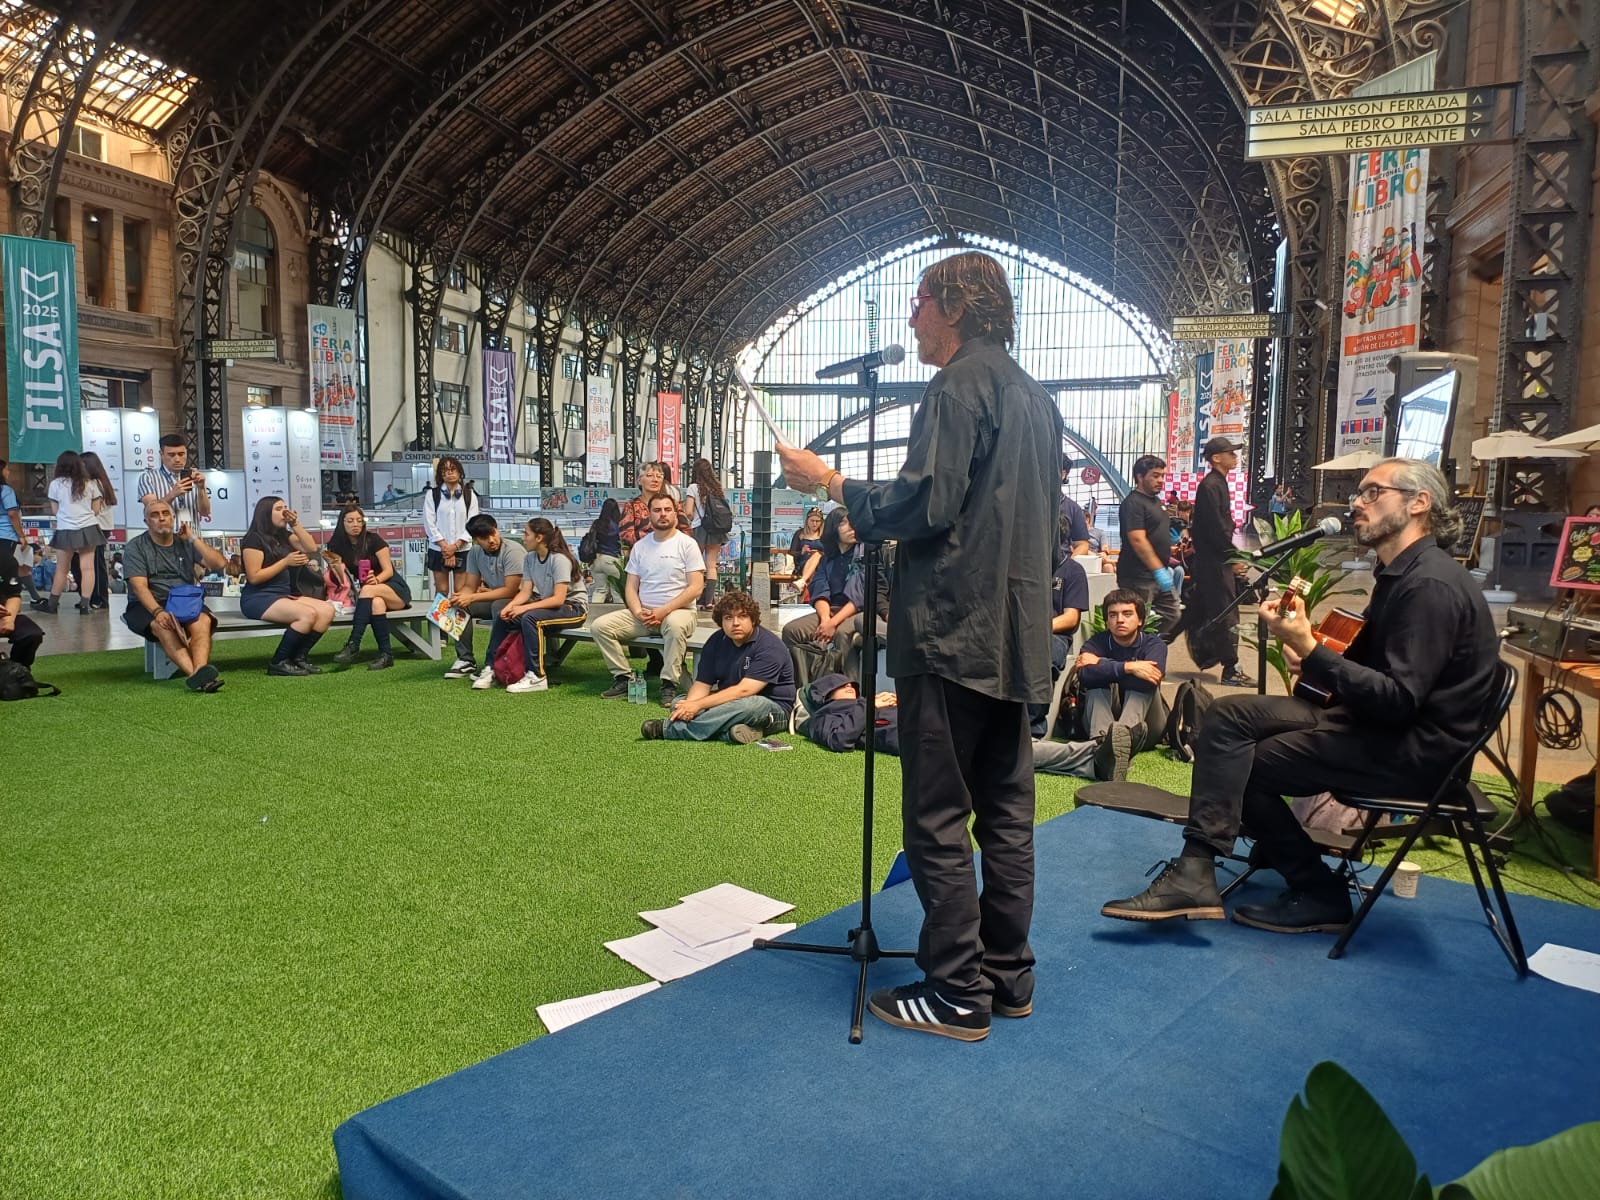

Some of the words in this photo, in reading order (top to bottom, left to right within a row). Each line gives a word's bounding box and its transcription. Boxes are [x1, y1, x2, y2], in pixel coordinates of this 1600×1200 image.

[1255, 109, 1293, 123] SALA
[1298, 102, 1384, 120] TENNYSON
[1389, 96, 1460, 112] FERRADA
[1299, 122, 1337, 136] SALA
[1342, 117, 1396, 132] PEDRO
[1401, 111, 1459, 127] PRADO
[1345, 128, 1458, 149] RESTAURANTE
[1356, 149, 1421, 183] FERIA
[1353, 167, 1423, 212] LIBRO
[23, 303, 60, 319] 2025
[312, 336, 352, 351] FERIA
[1217, 342, 1246, 357] FERIA
[1216, 356, 1246, 373] LIBRO
[22, 322, 65, 431] FILSA
[489, 397, 509, 459] FILSA
[404, 453, 431, 461] CENTRO
[662, 427, 676, 472] ILSA
[583, 499, 604, 508] LIBR
[732, 492, 753, 503] FER
[732, 505, 751, 515] LIB
